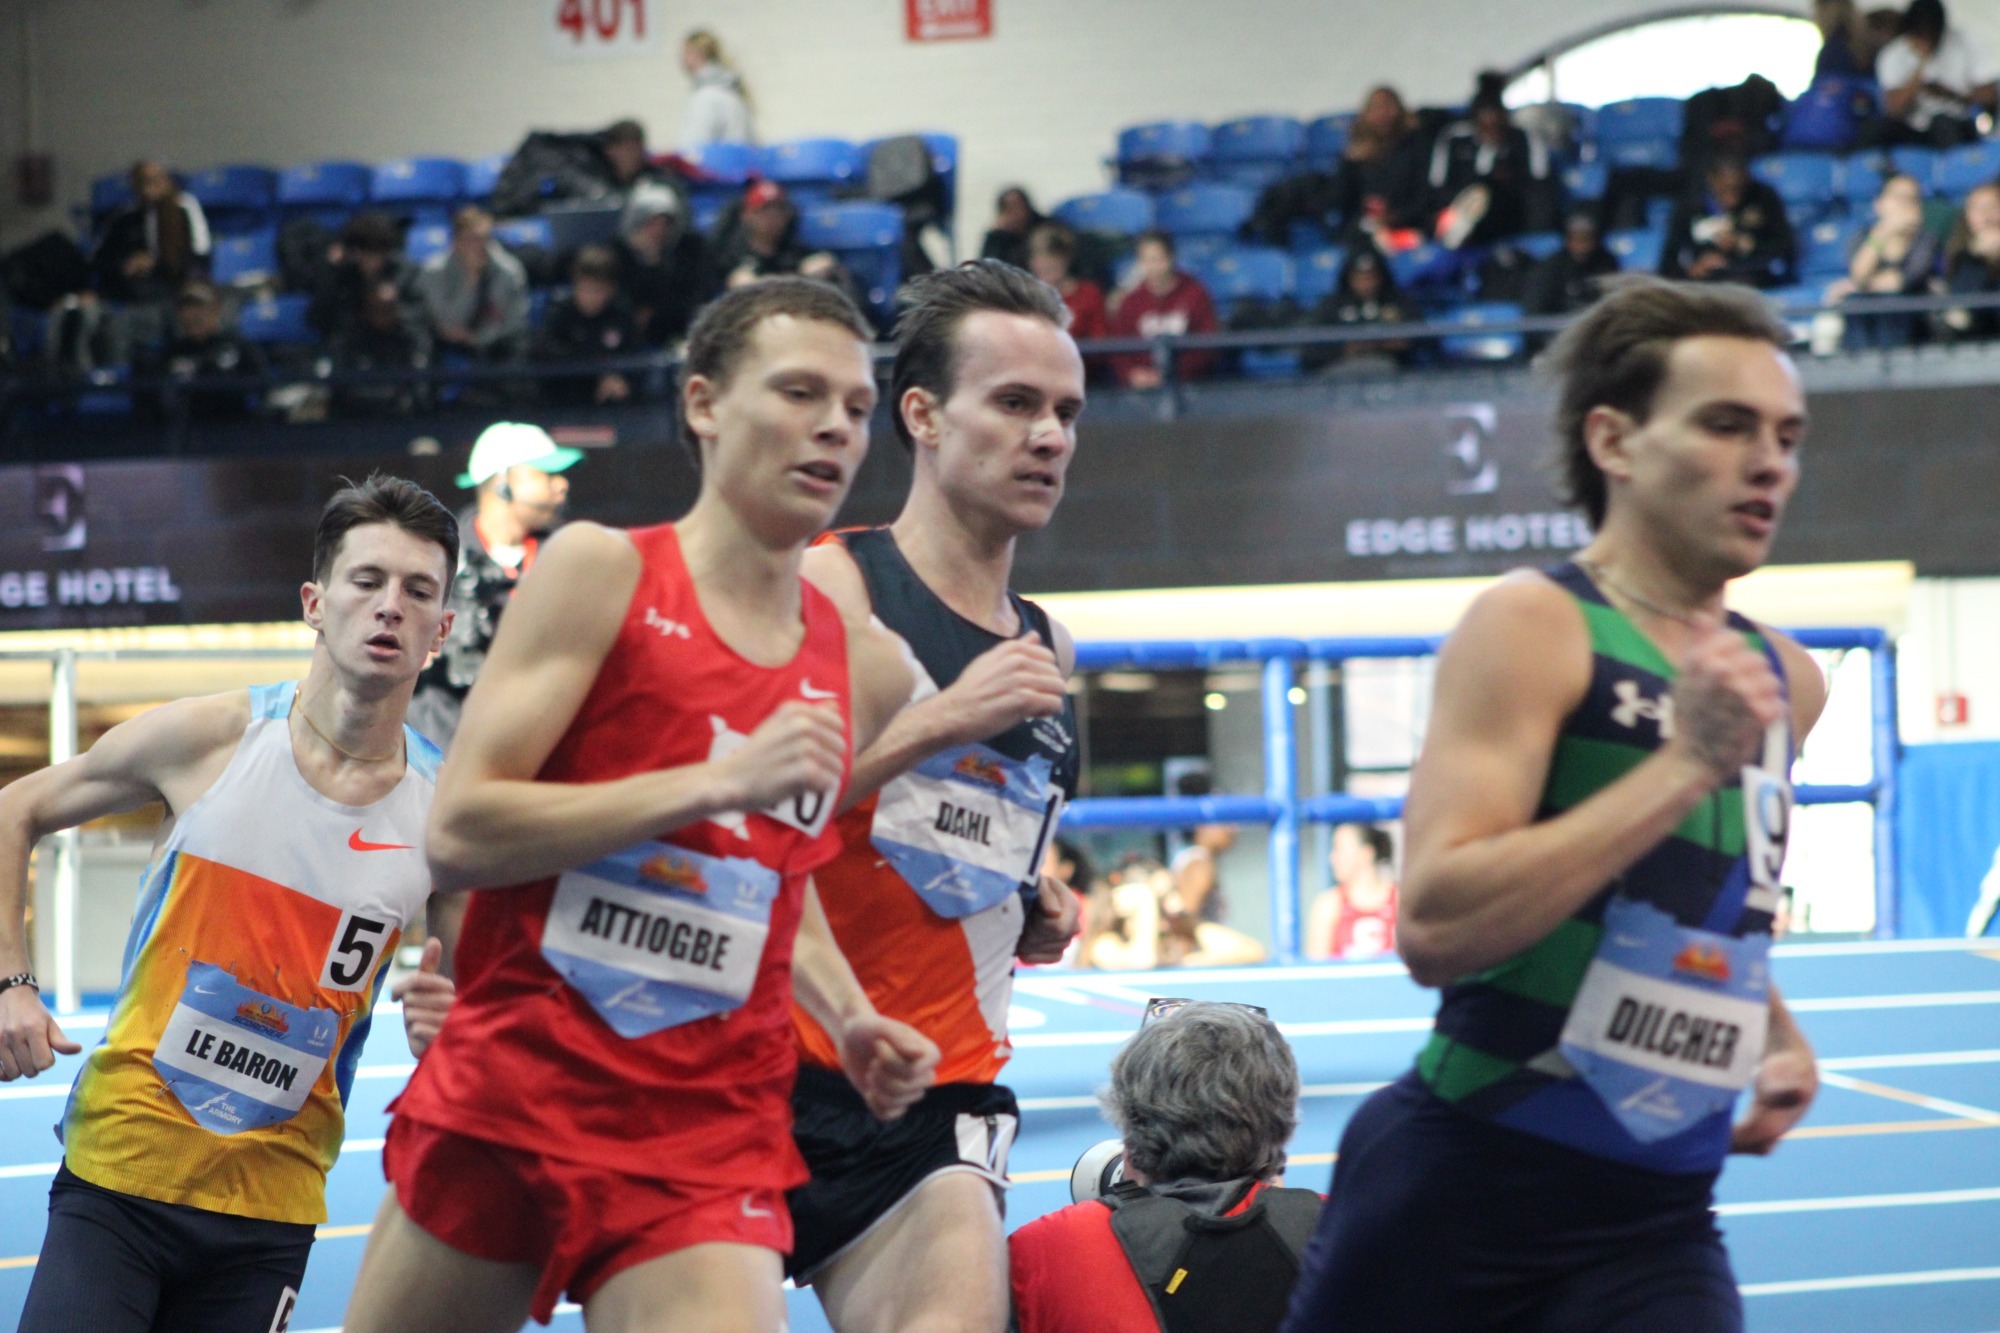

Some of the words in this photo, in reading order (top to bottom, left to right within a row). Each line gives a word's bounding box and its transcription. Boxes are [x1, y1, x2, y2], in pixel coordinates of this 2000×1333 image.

[1346, 518, 1456, 557] EDGE
[58, 566, 181, 605] HOTEL
[934, 801, 991, 847] DAHL
[329, 914, 386, 986] 5
[578, 897, 732, 972] ATTIOGBE
[1607, 994, 1741, 1071] DILCHER
[185, 1029, 217, 1061] LE
[213, 1039, 299, 1092] BARON
[208, 1107, 244, 1125] ARMORY
[221, 1102, 237, 1112] THE
